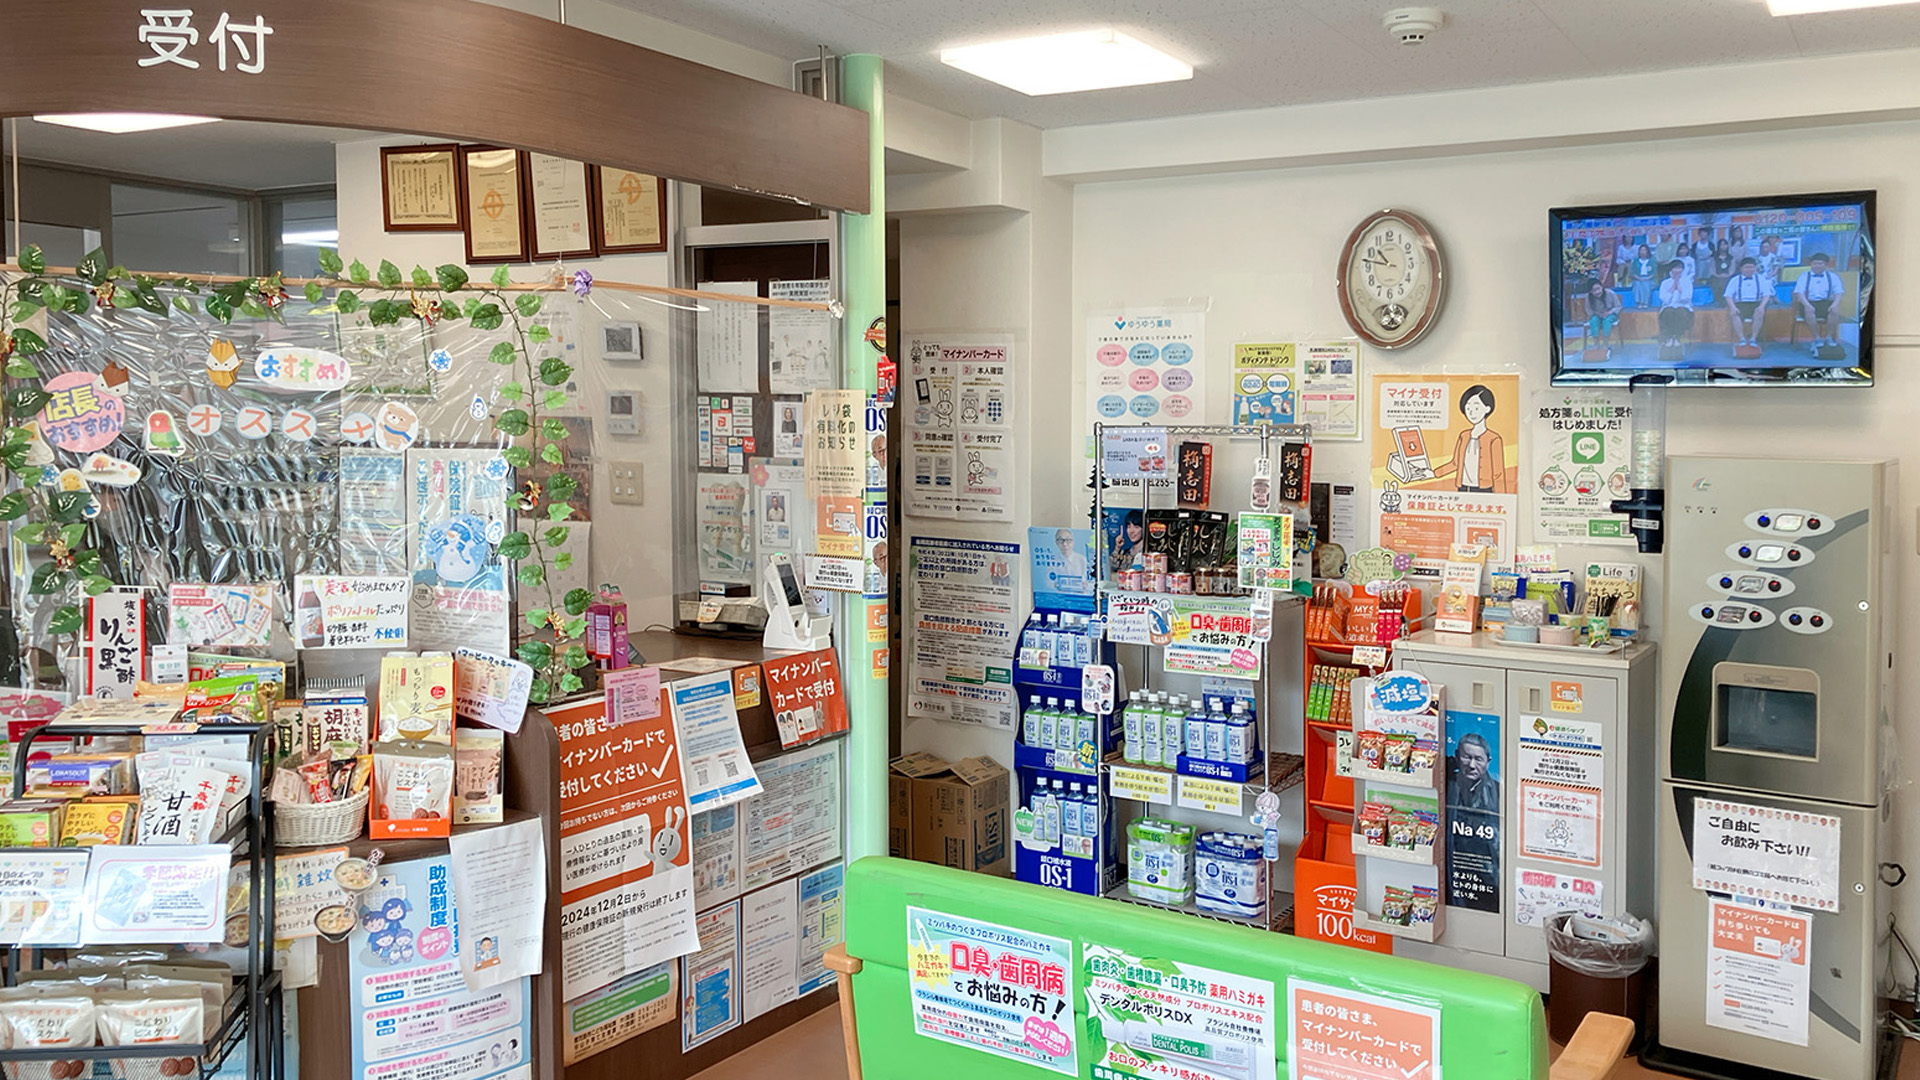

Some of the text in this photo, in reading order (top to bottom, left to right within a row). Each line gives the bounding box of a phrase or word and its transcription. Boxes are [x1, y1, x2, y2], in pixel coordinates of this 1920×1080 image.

[138, 8, 274, 75] 受付
[1128, 319, 1172, 329] ゆうゆう薬局
[943, 349, 1004, 360] マイナンバーカード
[1241, 356, 1290, 364] ボディメンテ ドリンク
[260, 354, 346, 382] おすすめ!
[977, 366, 1004, 375] 本人確認
[45, 383, 118, 422] 店長の
[1387, 388, 1442, 399] マイナ受付
[46, 415, 123, 445] おすすめ!
[1553, 420, 1622, 431] はじめました!
[976, 433, 1003, 444] 受付完了
[1580, 443, 1597, 451] LINE
[1407, 501, 1507, 514] 保険証として使えます。
[1602, 566, 1623, 577] Life
[1588, 586, 1635, 598] はちみつ
[374, 627, 404, 639] 不使用
[1192, 632, 1256, 649] でお悩みの方!
[769, 657, 832, 684] マイナンバー
[410, 667, 422, 715] もっちり麦
[775, 677, 835, 708] カードで受付
[1380, 683, 1422, 704] 減塩
[323, 708, 344, 744] 胡麻
[560, 729, 666, 768] イナンバーカードで
[1529, 791, 1593, 805] マイナンバーカード
[1538, 801, 1583, 812] をご利用ください
[68, 811, 95, 820] カラダに
[153, 790, 192, 837] 甘酒
[1452, 820, 1495, 840] Na 49
[1708, 816, 1760, 834] ご自由に
[1721, 834, 1811, 858] お飲み下さい!!
[1040, 864, 1072, 889] OS-1
[1453, 871, 1483, 883] 水よりも、
[428, 864, 448, 928] 助成制度
[1453, 881, 1494, 894] ヒトの身体に
[1453, 890, 1479, 900] 近い水。
[561, 890, 647, 927] 2024年12月2日から
[1316, 893, 1355, 910] マイサ
[1717, 918, 1771, 936] 持ち歩いても
[1718, 907, 1800, 930] マイナンバーカードは
[927, 917, 1052, 952] ミツバチのつくるプロポリス配合のハミガキ
[1316, 913, 1377, 945] 100kcal
[1717, 929, 1744, 941] 大丈夫
[950, 941, 1066, 997] 口臭・歯周病
[1092, 958, 1266, 1008] 歯肉炎・歯槽膿漏・口臭予防 薬用ハミガキ
[954, 978, 1067, 1021] でお悩みの方!
[1094, 979, 1263, 1025] ミツバチのつくる天然成分 プロポリスエキス配合
[1099, 993, 1193, 1025] デンタルポリスDX
